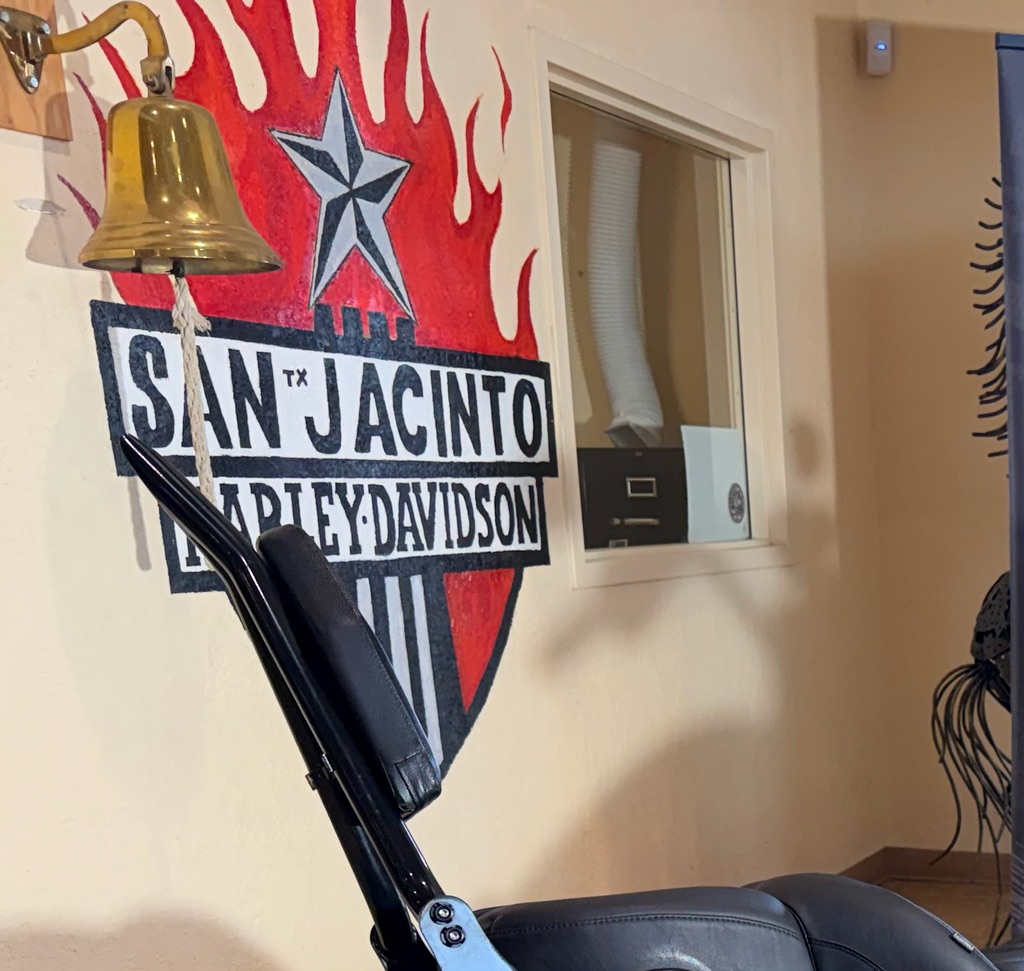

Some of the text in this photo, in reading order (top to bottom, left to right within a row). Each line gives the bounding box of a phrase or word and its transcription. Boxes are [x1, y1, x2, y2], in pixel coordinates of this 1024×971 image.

[129, 334, 542, 458] SAN TX JACINTO
